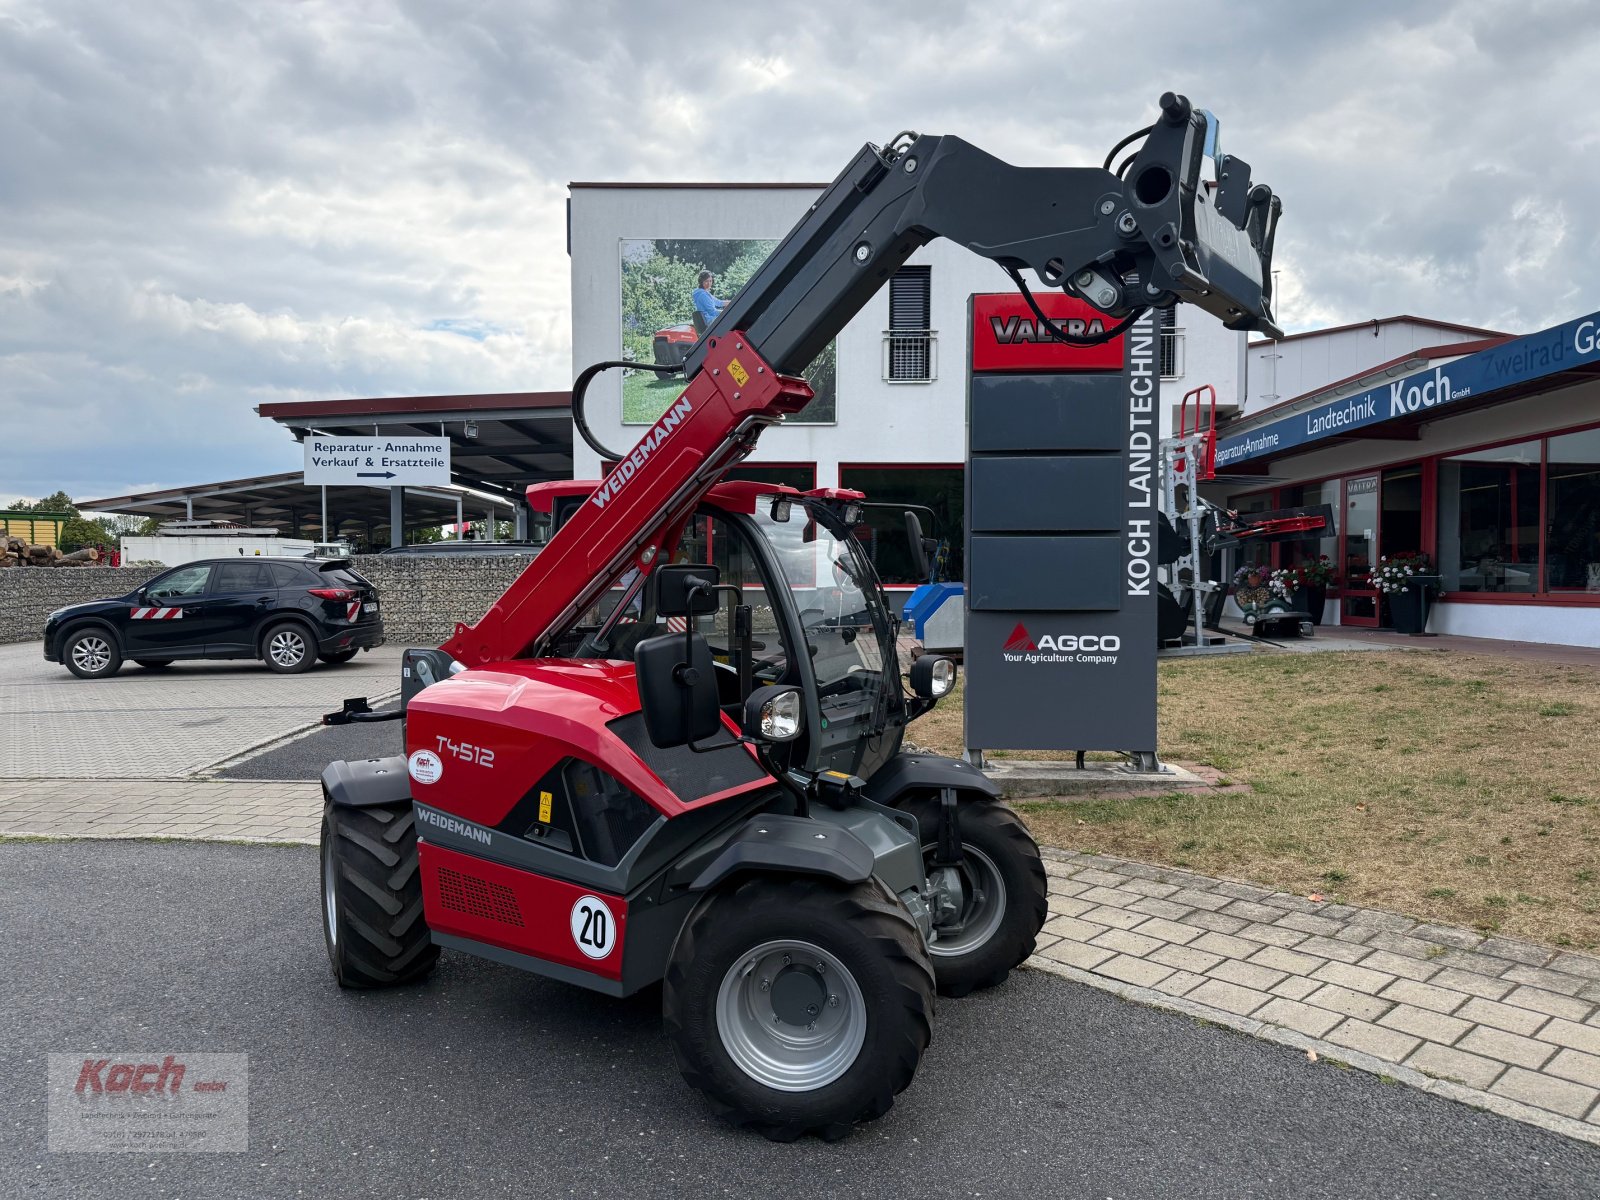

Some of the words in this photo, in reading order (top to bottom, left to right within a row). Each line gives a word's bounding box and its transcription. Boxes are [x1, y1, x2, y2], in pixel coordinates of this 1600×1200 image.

[1128, 307, 1154, 508] LANDTECHNIK
[1307, 395, 1376, 435] Landtechnik
[1390, 367, 1450, 417] Koch
[1452, 387, 1471, 399] GmbH
[312, 457, 359, 467] Verkauf
[365, 458, 374, 467] &
[381, 458, 445, 468] Ersatzteile
[314, 443, 374, 455] Reparatur
[385, 443, 442, 453] Annahme
[591, 396, 693, 509] WEIDEMANN
[1127, 519, 1151, 596] KOCH
[1003, 653, 1023, 662] Your
[1024, 653, 1074, 664] Agriculture
[1076, 653, 1118, 665] Company
[1037, 634, 1121, 652] AGCO
[436, 734, 495, 769] T4512
[417, 807, 492, 846] WEIDEMANN
[580, 905, 606, 949] 20
